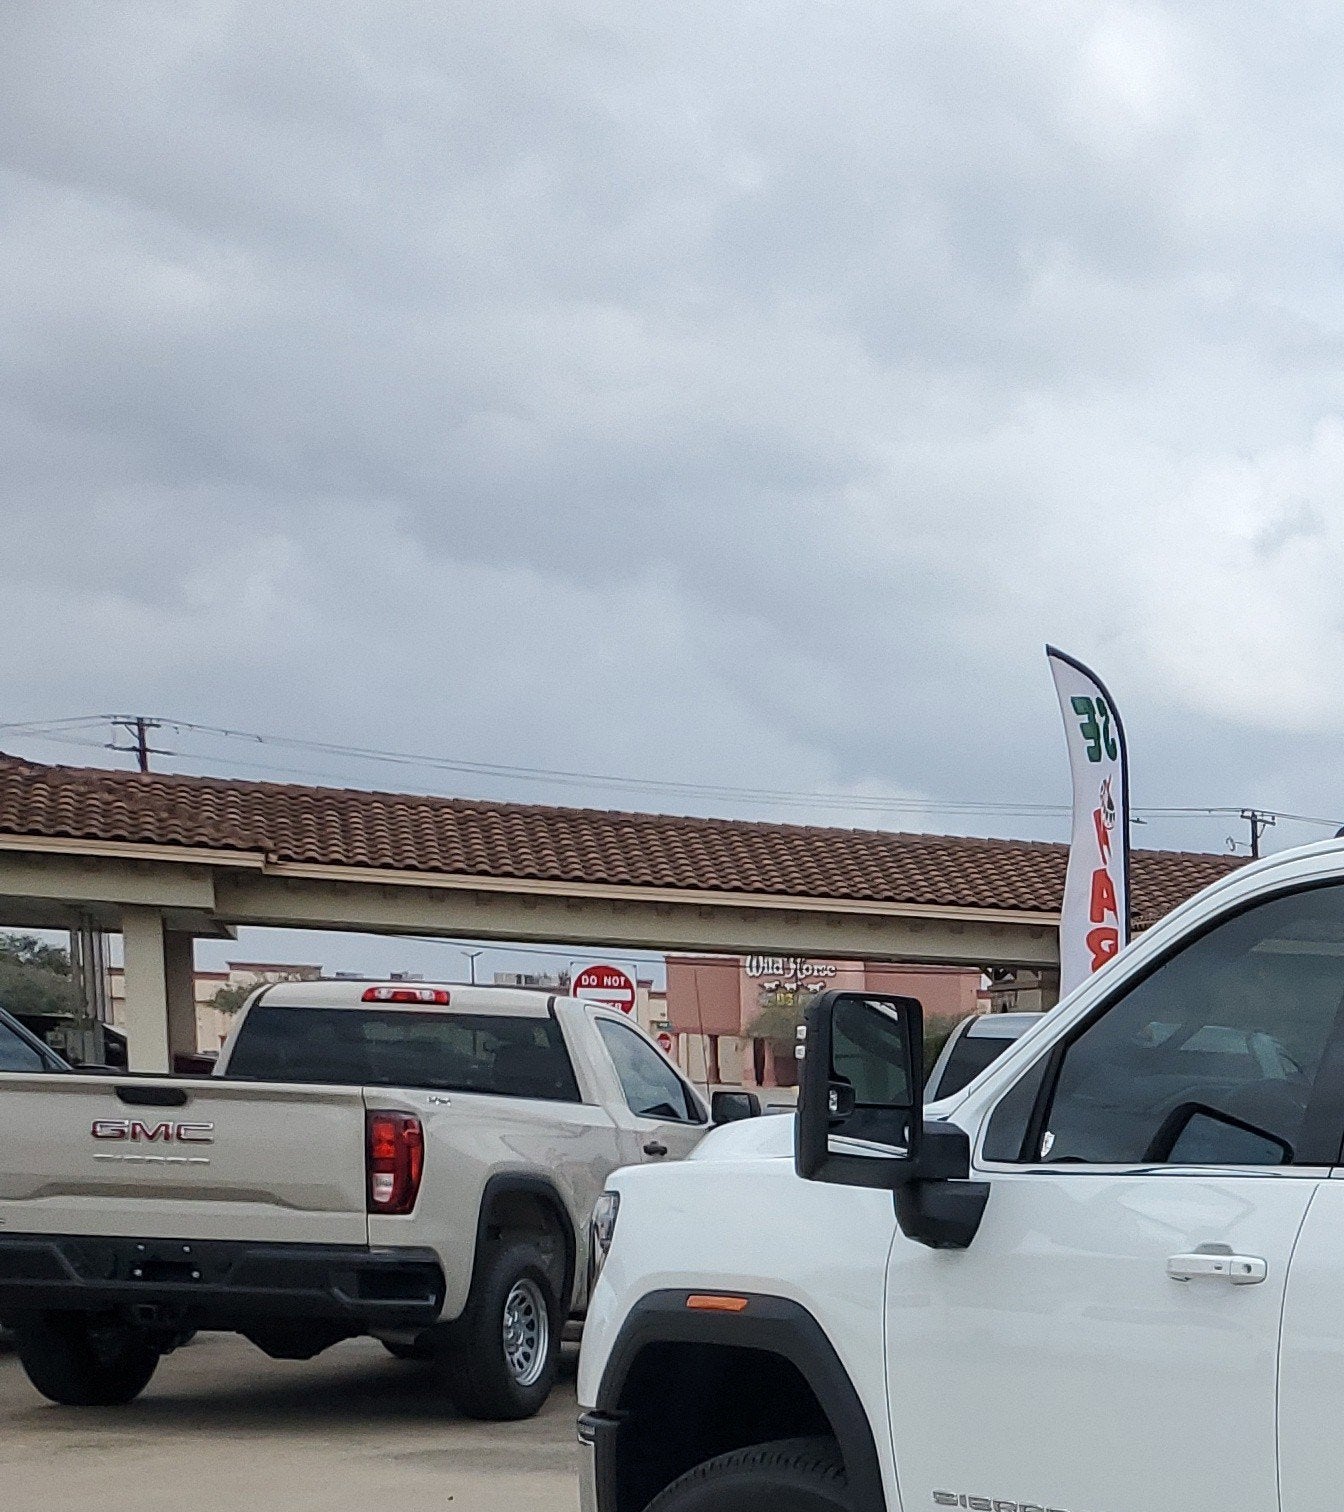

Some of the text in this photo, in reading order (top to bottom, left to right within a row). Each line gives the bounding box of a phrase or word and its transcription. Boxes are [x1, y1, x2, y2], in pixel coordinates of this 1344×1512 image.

[582, 975, 626, 987] DO NOT
[91, 1118, 214, 1145] GMC
